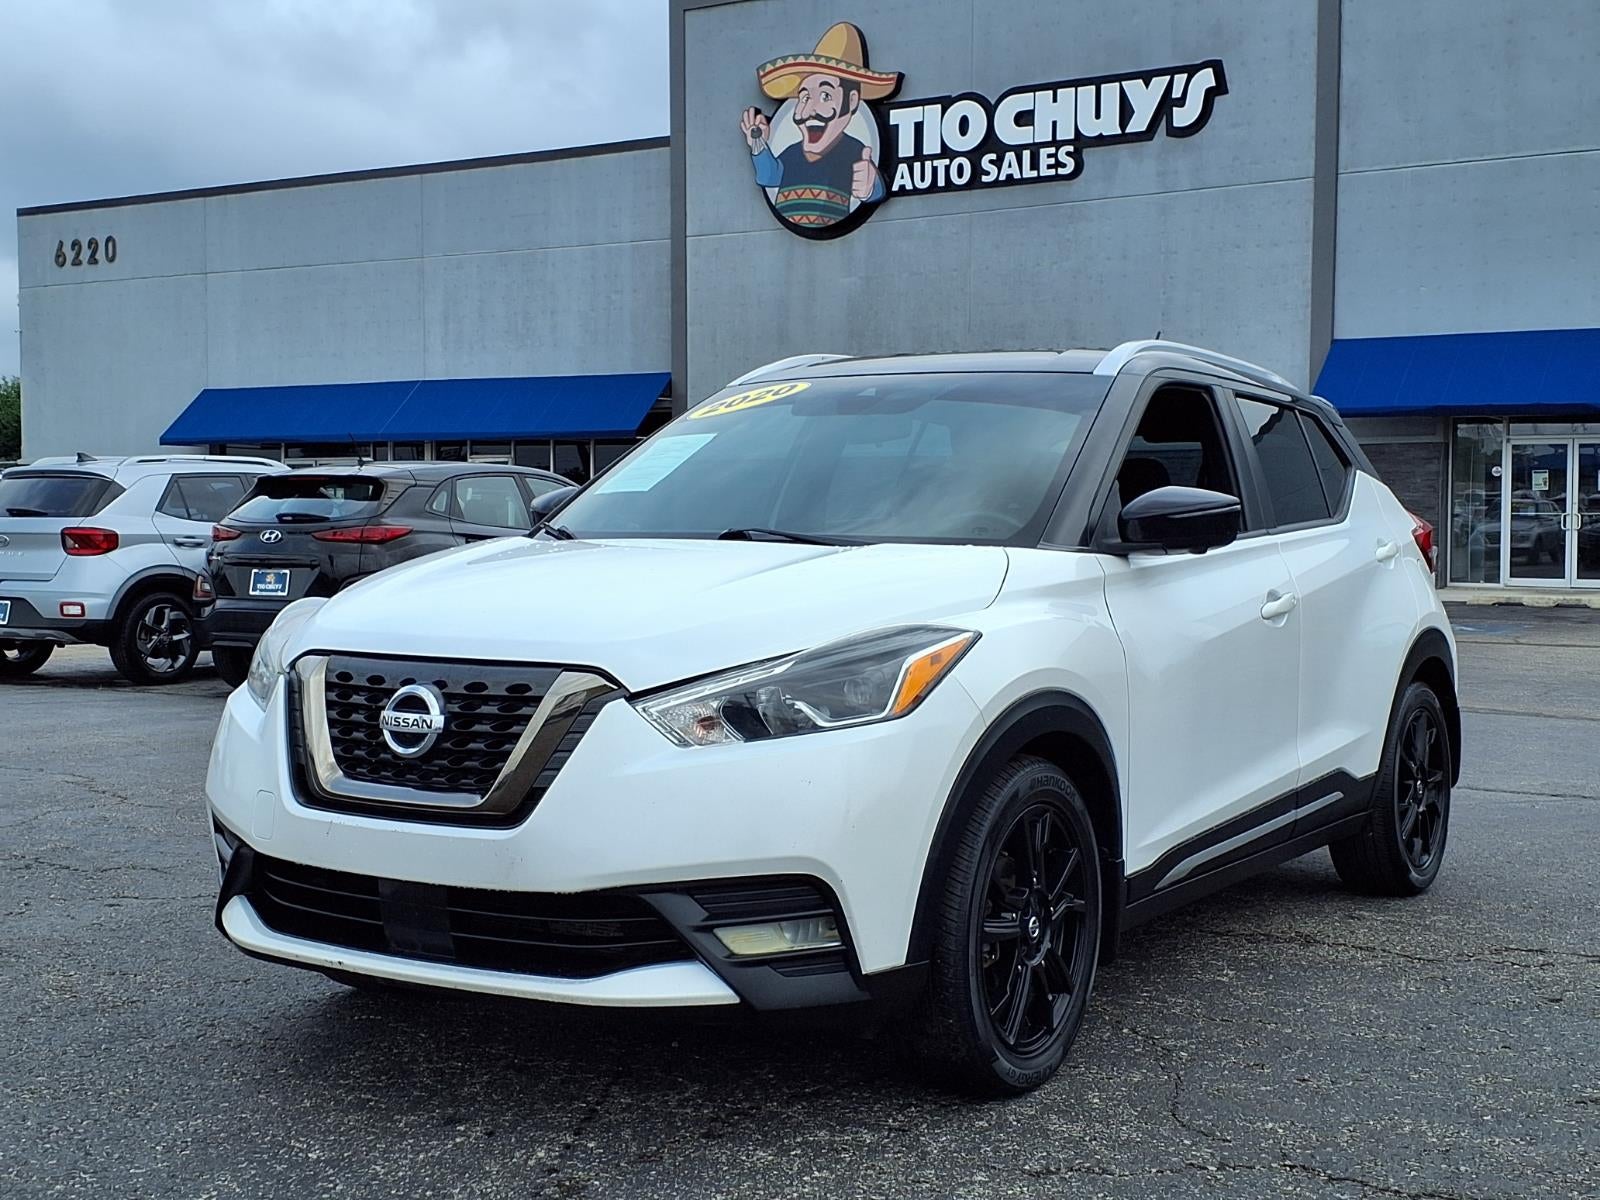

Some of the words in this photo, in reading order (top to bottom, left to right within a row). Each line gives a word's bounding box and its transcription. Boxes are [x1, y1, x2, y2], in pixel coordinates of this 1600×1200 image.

[890, 99, 988, 158] TIO
[993, 67, 1216, 146] CHUY'S
[891, 156, 972, 192] AUTO
[980, 144, 1075, 183] SALES
[54, 235, 117, 268] 6220
[699, 383, 799, 417] 2020
[382, 714, 434, 730] NISSAN
